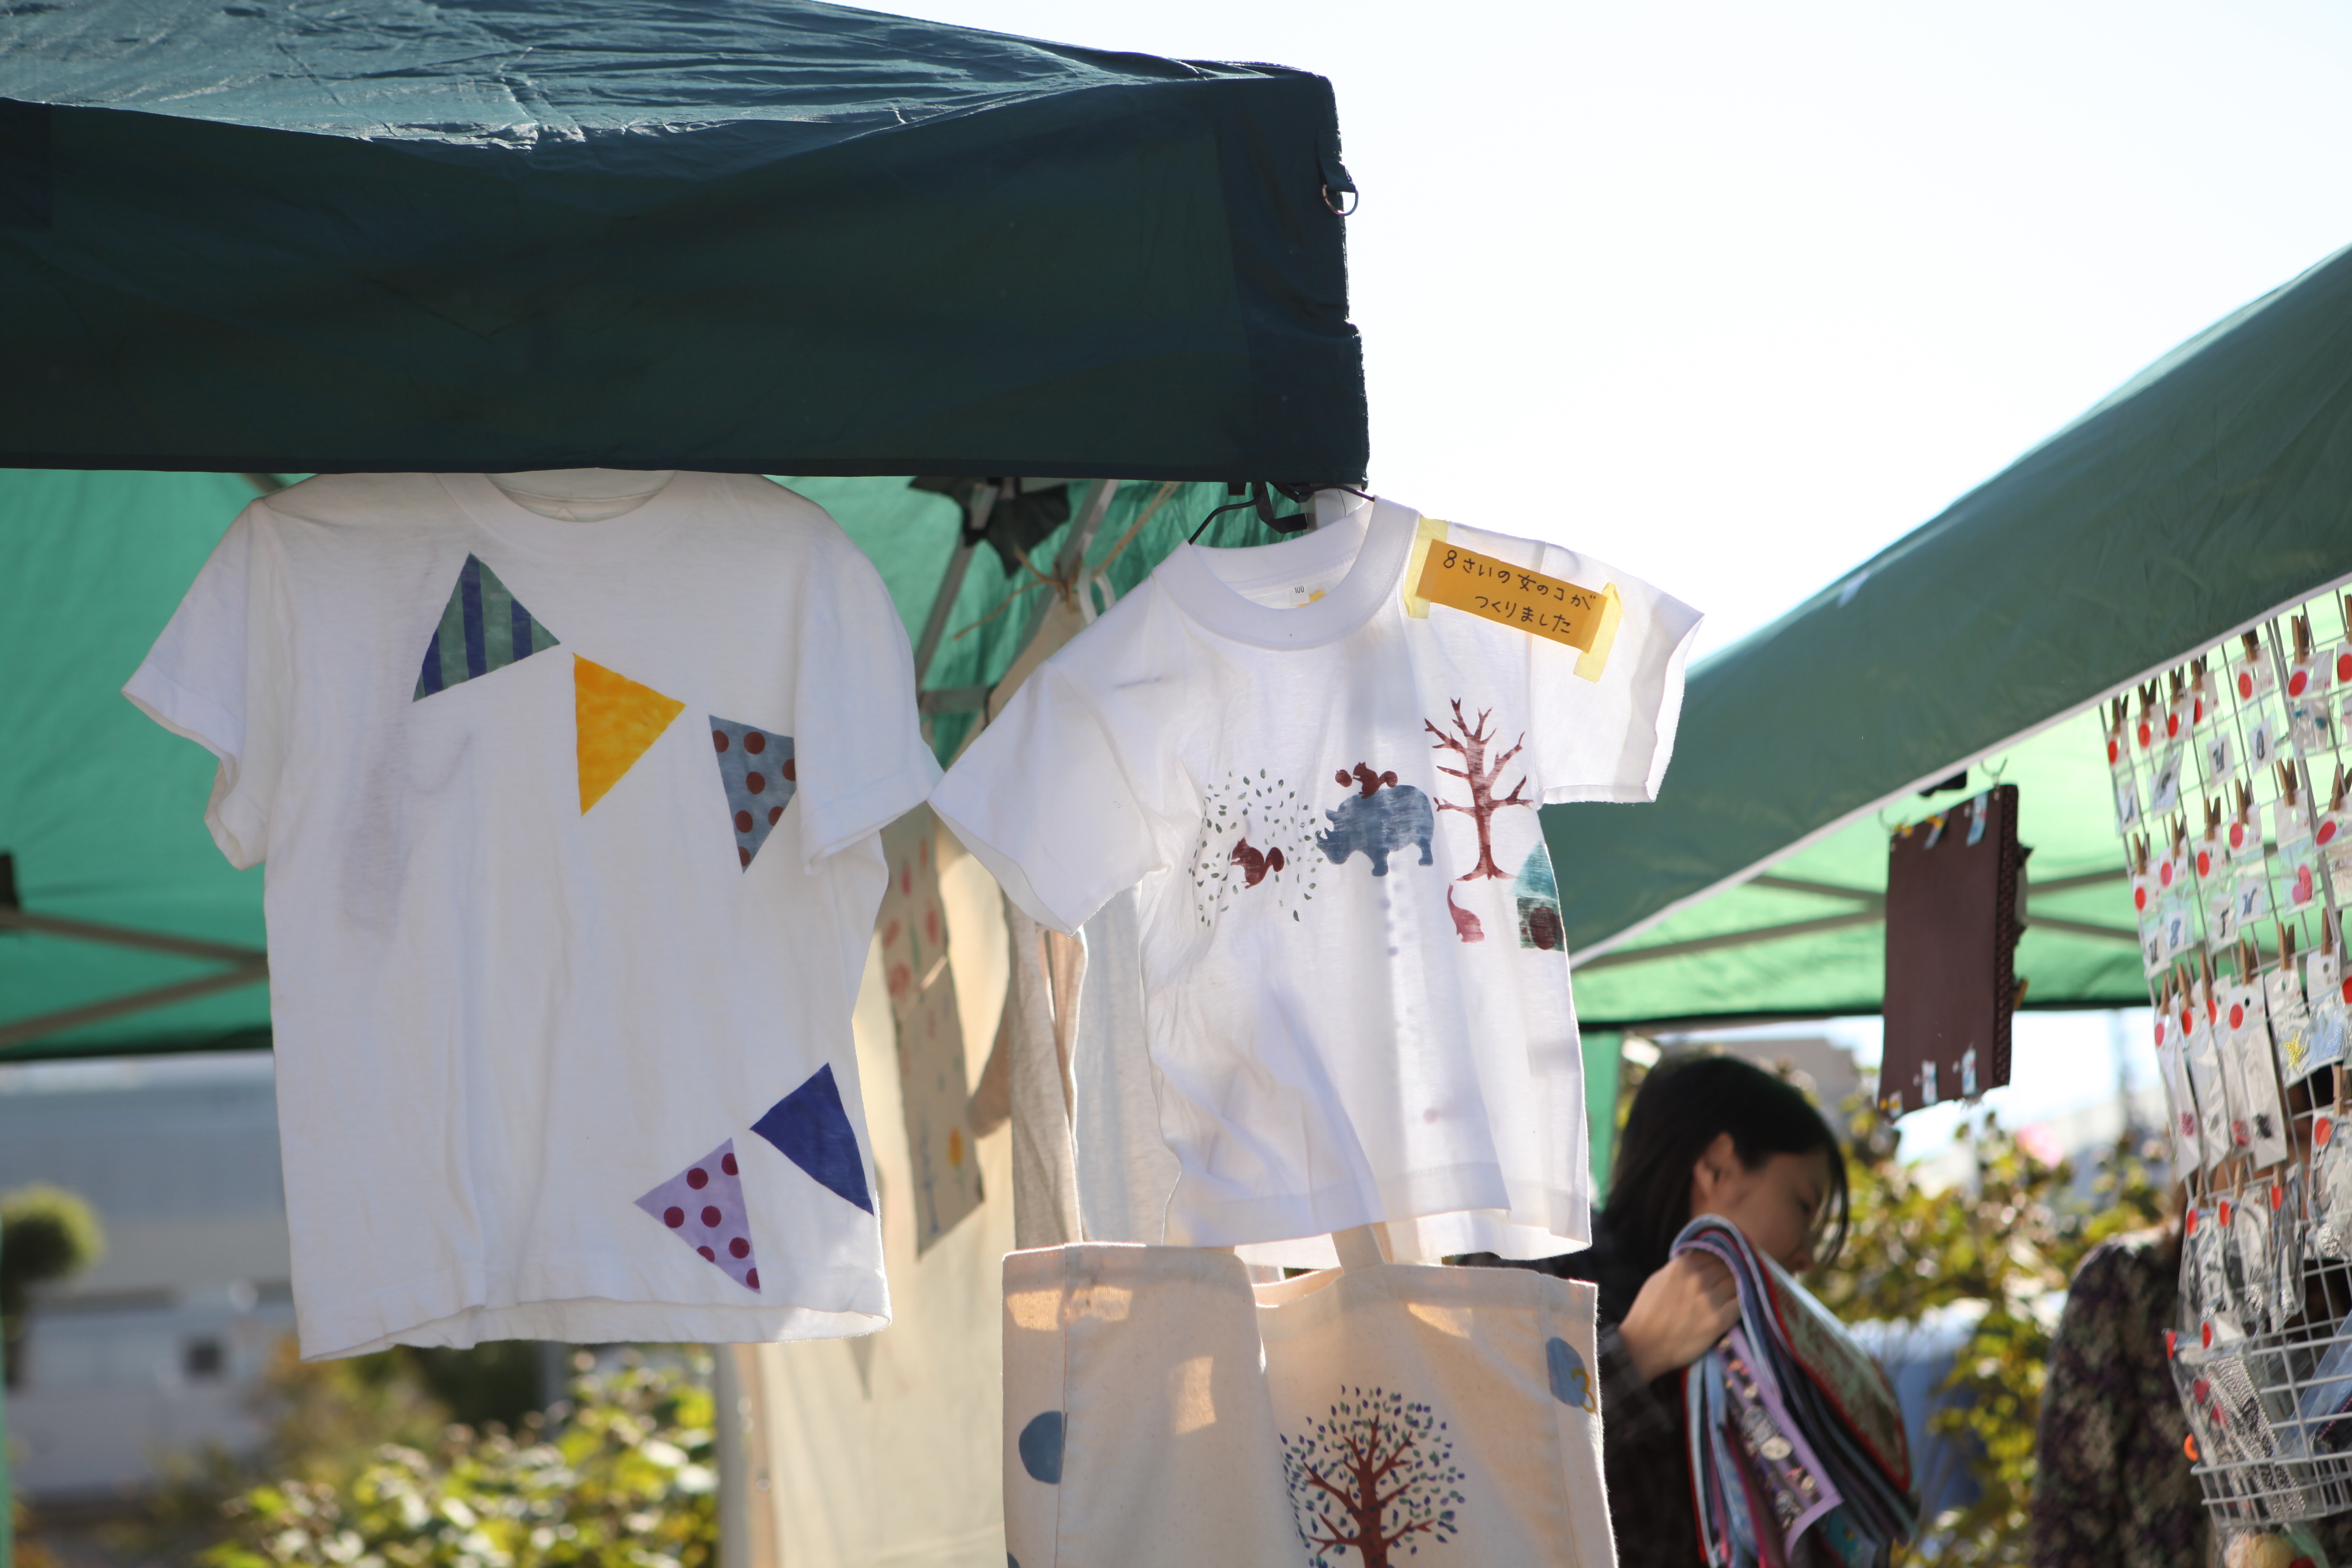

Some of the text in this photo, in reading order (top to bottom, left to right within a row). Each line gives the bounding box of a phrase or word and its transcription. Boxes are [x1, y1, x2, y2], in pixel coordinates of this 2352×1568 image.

[1475, 596, 1571, 634] つくりました
